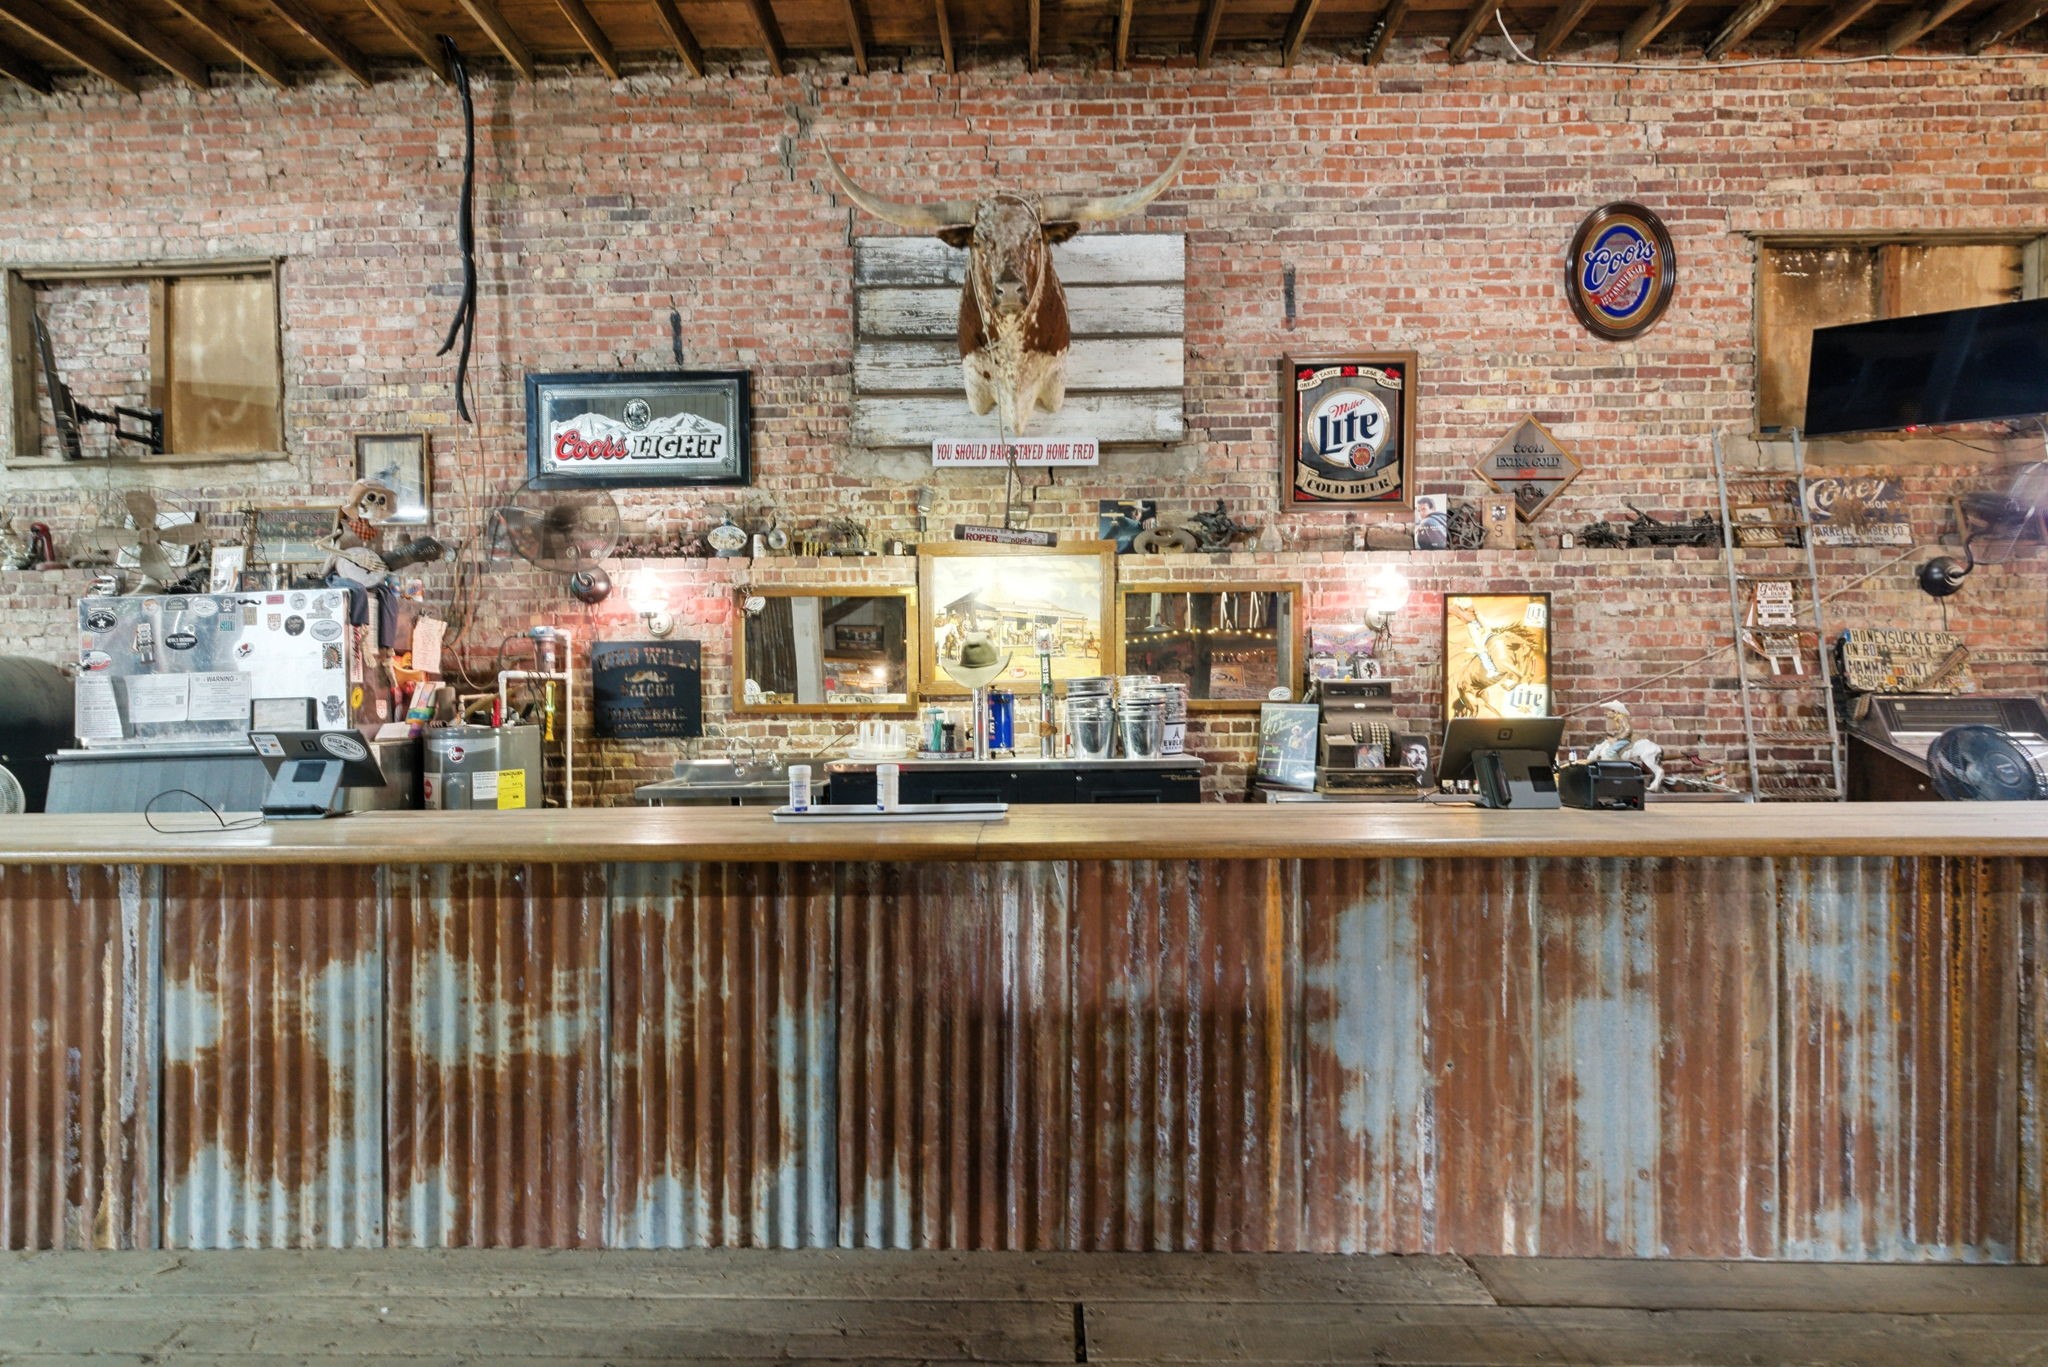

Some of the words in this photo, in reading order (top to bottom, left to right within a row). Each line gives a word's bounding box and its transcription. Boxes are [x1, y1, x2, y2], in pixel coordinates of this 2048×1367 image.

[1583, 240, 1656, 293] Coors
[1320, 369, 1338, 378] TASTE
[1362, 369, 1378, 377] LESS
[1328, 399, 1366, 418] Miller
[1318, 411, 1379, 455] Lite
[554, 429, 630, 460] Coors
[631, 434, 721, 459] LIGHT
[937, 444, 952, 460] YOU
[955, 443, 987, 460] SHOULD
[1014, 443, 1043, 460] STAYED
[1046, 443, 1070, 460] HOME
[1072, 443, 1095, 460] FRED
[1513, 443, 1545, 453] Coors
[1495, 456, 1531, 468] EXTRA
[1532, 457, 1561, 467] GOLD
[1306, 479, 1346, 495] COLD
[1349, 478, 1390, 495] BEER
[965, 533, 999, 543] ROPER
[1851, 630, 1933, 646] HONEYSUCKLE
[1846, 643, 1858, 656] ON
[596, 647, 640, 672] WILD
[206, 675, 235, 683] WARNING
[619, 683, 675, 697] SALOON
[1510, 689, 1542, 708] Lite
